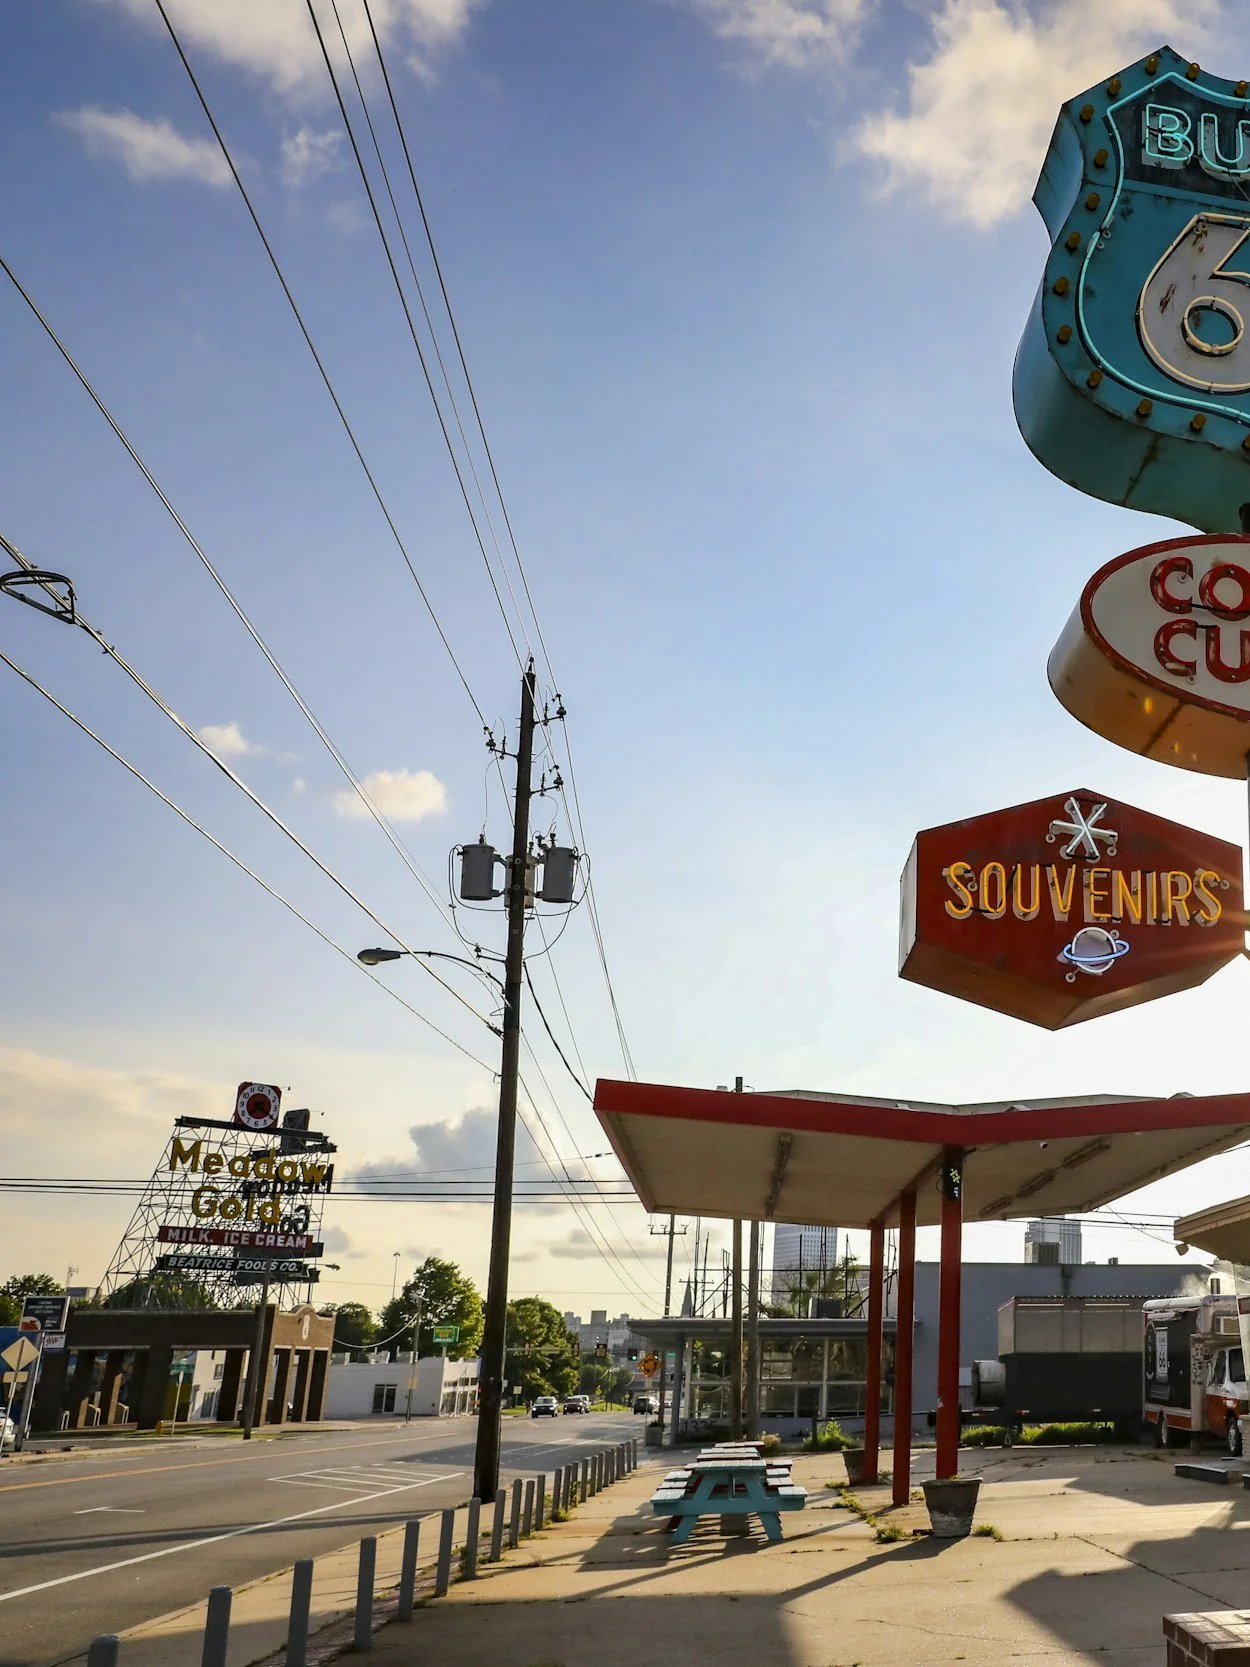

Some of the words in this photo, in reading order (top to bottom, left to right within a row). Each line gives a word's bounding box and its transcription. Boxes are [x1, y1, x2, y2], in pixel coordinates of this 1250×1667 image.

[942, 861, 1226, 927] SOUVENIRS
[169, 1137, 326, 1184] Meadow
[192, 1185, 281, 1224] Gold
[224, 1231, 250, 1245] ICE
[255, 1233, 307, 1249] CREAM
[168, 1256, 234, 1269] BEATRICE
[279, 1262, 299, 1272] CO.
